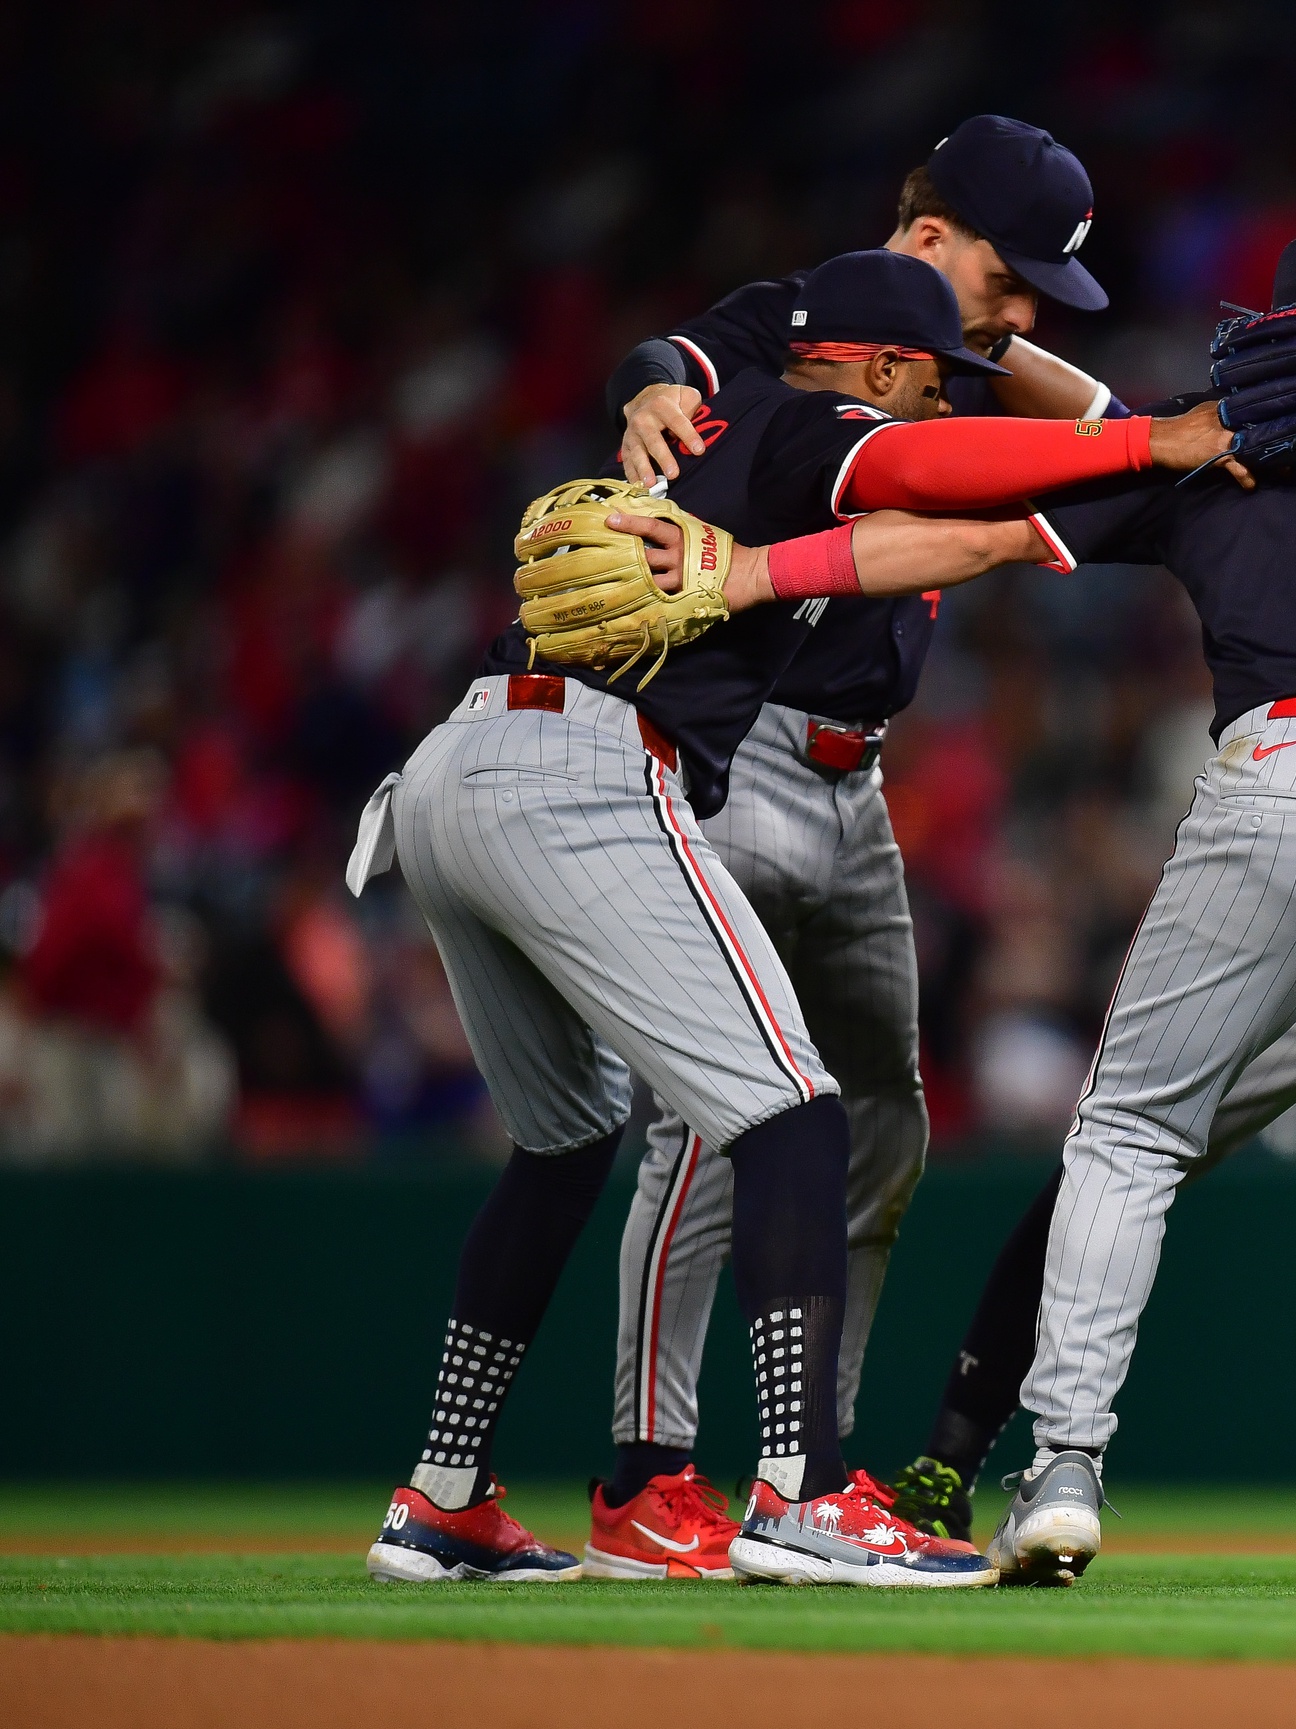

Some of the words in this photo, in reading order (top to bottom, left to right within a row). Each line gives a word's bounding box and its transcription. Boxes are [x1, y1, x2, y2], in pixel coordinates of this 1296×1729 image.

[530, 519, 573, 541] A2000
[700, 523, 718, 571] Wilson
[553, 611, 569, 622] MJF
[382, 1502, 410, 1530] 50
